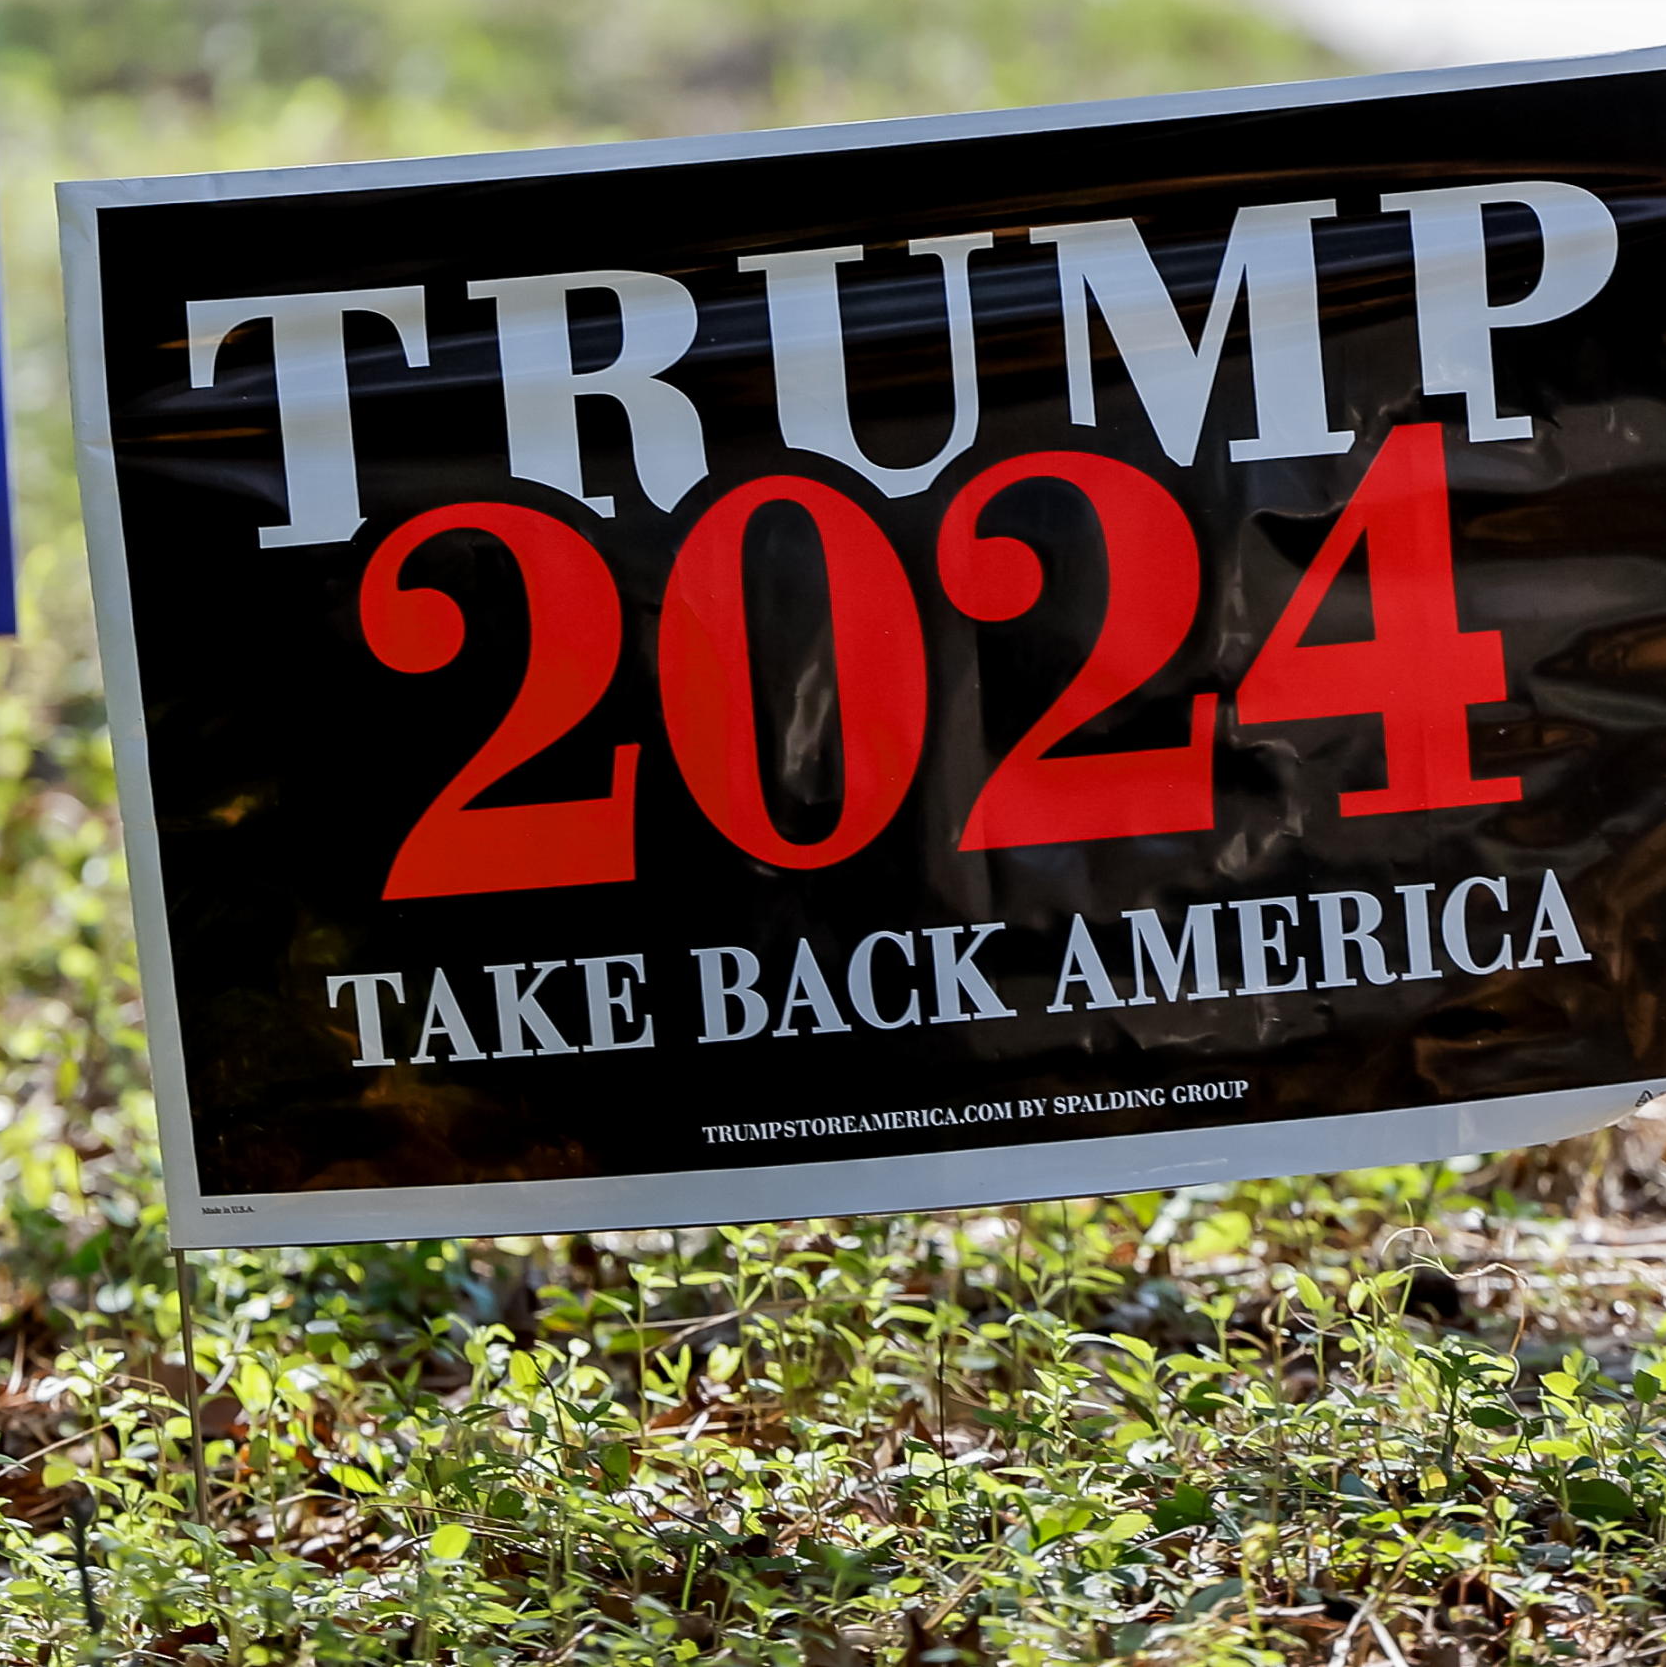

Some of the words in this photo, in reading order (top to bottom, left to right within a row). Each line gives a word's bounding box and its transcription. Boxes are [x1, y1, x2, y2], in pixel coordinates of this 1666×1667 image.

[186, 181, 1618, 549] TRUMP
[359, 422, 1524, 900] 2024
[326, 952, 655, 1067] TAKE
[691, 922, 1018, 1043] BACK
[1046, 867, 1592, 1013] AMERICA
[702, 1101, 1013, 1144] TRUMPSTOREAMERICA.COM
[1018, 1097, 1048, 1119] BY
[1053, 1088, 1166, 1116] SPALDING
[1171, 1080, 1249, 1104] GROUP
